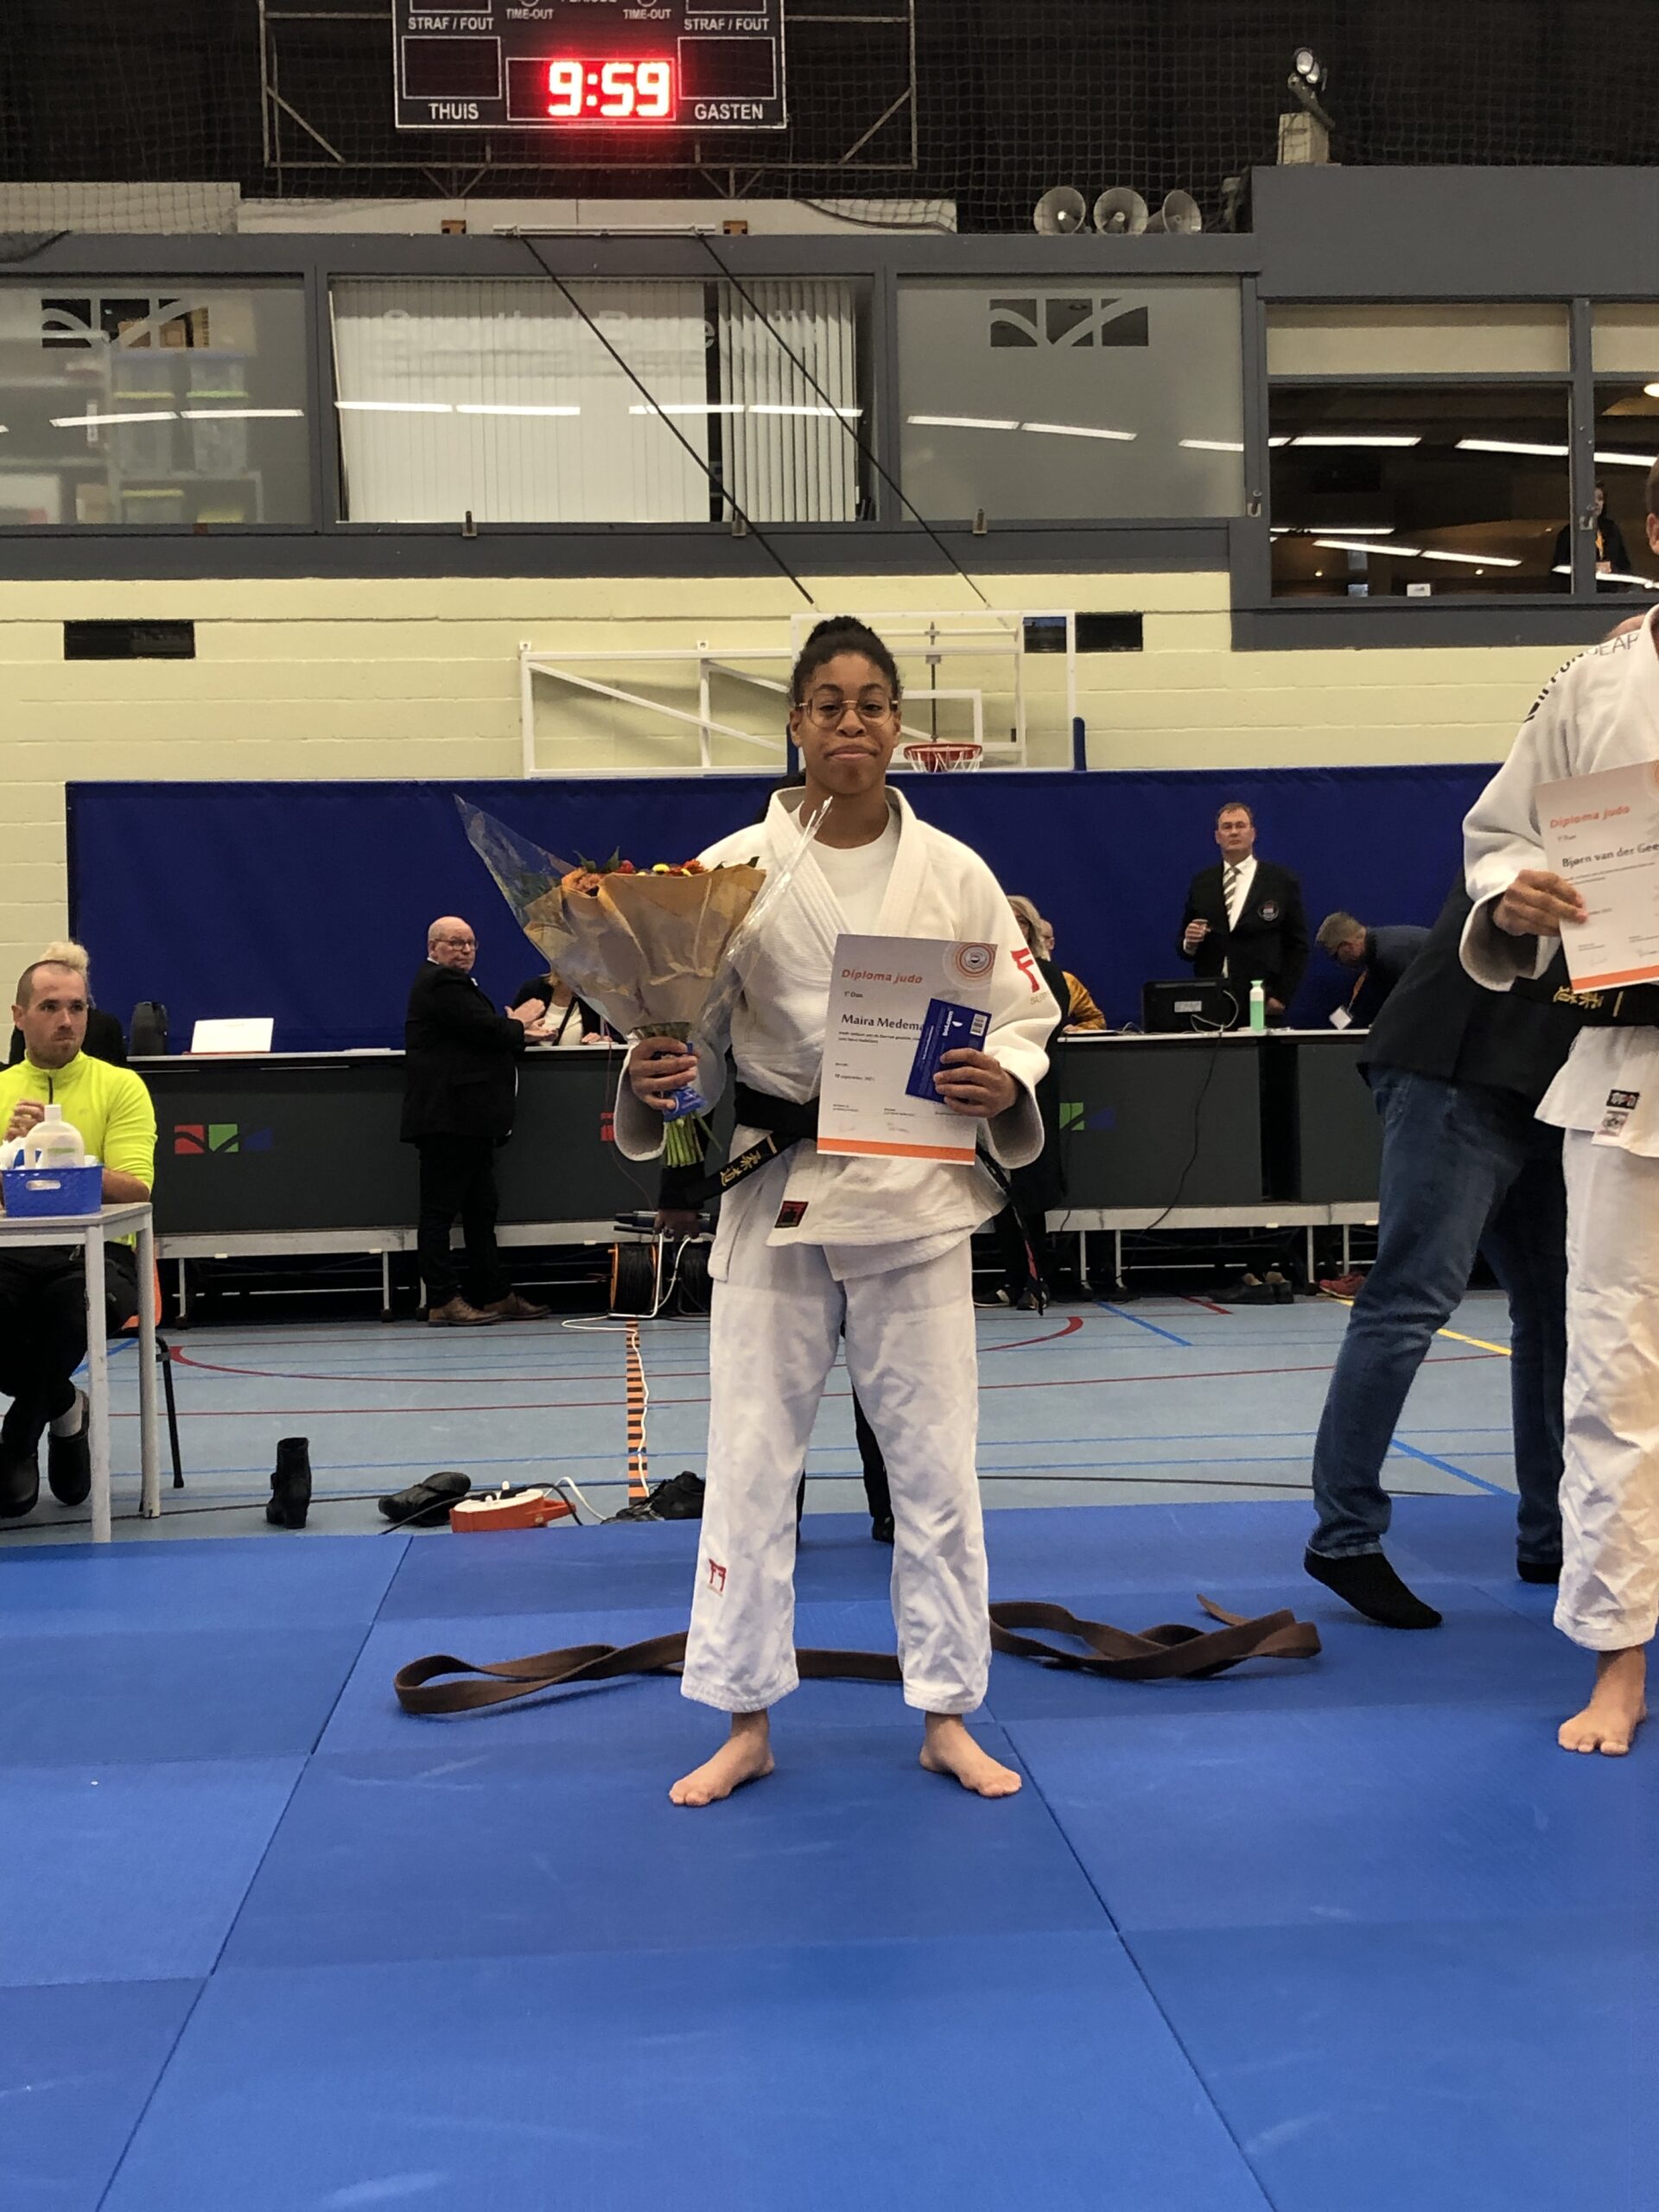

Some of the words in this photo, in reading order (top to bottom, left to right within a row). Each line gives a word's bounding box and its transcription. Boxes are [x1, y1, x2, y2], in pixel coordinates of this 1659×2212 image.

[505, 8, 554, 19] TIME-OUT
[623, 9, 671, 19] TIME-OUT
[408, 17, 449, 29] STRAF
[460, 17, 493, 30] FOUT
[683, 18, 725, 30] STRAF
[735, 18, 769, 30] FOUT
[548, 61, 671, 117] 9:59
[428, 103, 479, 120] THUIS
[694, 103, 763, 120] GASTEN
[1550, 813, 1599, 829] Diploma
[1604, 806, 1630, 820] judo
[1594, 851, 1614, 861] van
[1616, 847, 1635, 857] der
[841, 969, 893, 982] Diploma
[893, 972, 924, 985] judo
[841, 1013, 874, 1027] Maira
